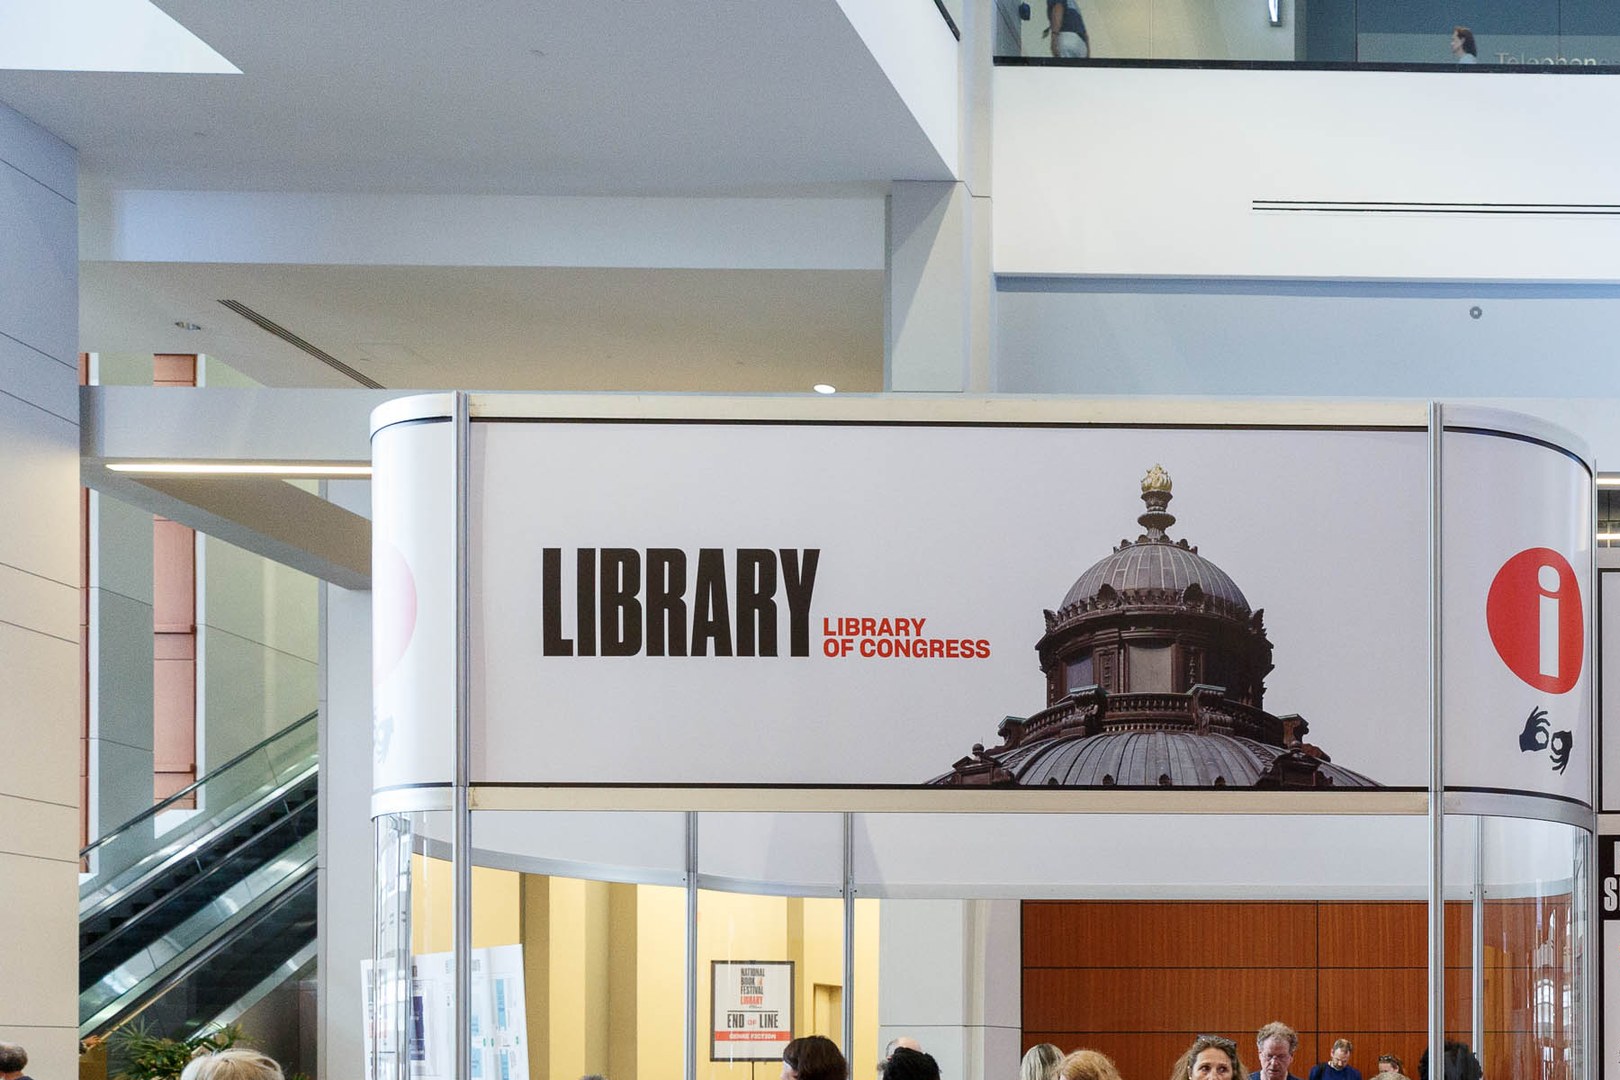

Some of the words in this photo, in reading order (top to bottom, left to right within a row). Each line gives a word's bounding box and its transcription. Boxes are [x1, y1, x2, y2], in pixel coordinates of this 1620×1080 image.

[543, 548, 820, 657] LIBRARY
[824, 618, 926, 636] LIBRARY
[824, 638, 853, 657] OF
[860, 639, 990, 658] CONGRESS
[741, 968, 765, 977] NATIONAL
[741, 986, 763, 994] FESTIVAL
[727, 1014, 745, 1028] END
[760, 1014, 778, 1028] LINE
